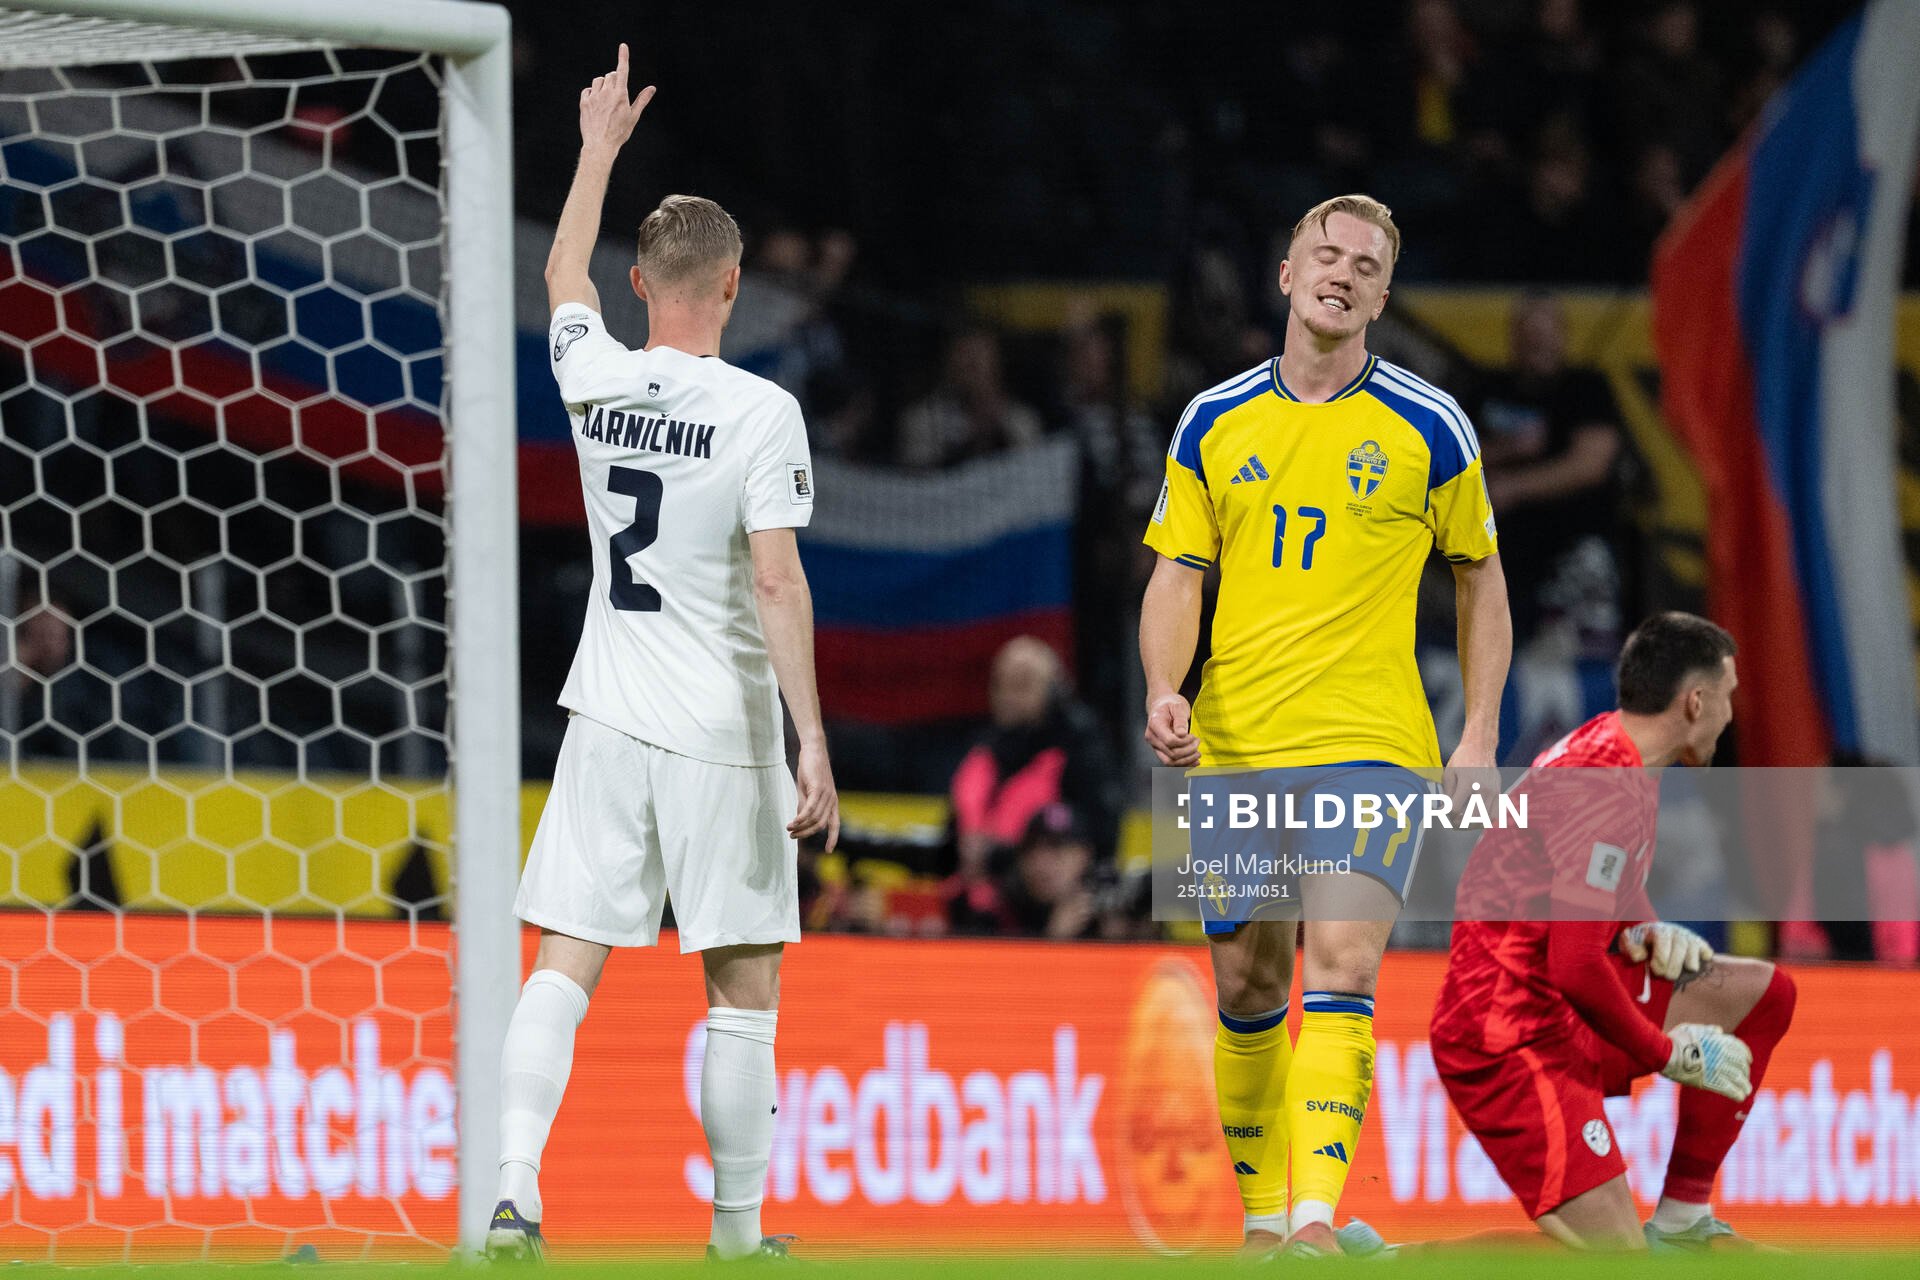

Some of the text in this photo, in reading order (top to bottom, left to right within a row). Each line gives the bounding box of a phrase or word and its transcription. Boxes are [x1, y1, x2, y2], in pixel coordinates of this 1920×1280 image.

[607, 465, 664, 612] 2
[1272, 504, 1327, 570] 17
[142, 1017, 460, 1200] matche
[1222, 1124, 1264, 1139] VERIGE
[1306, 1100, 1364, 1126] SVERIGE
